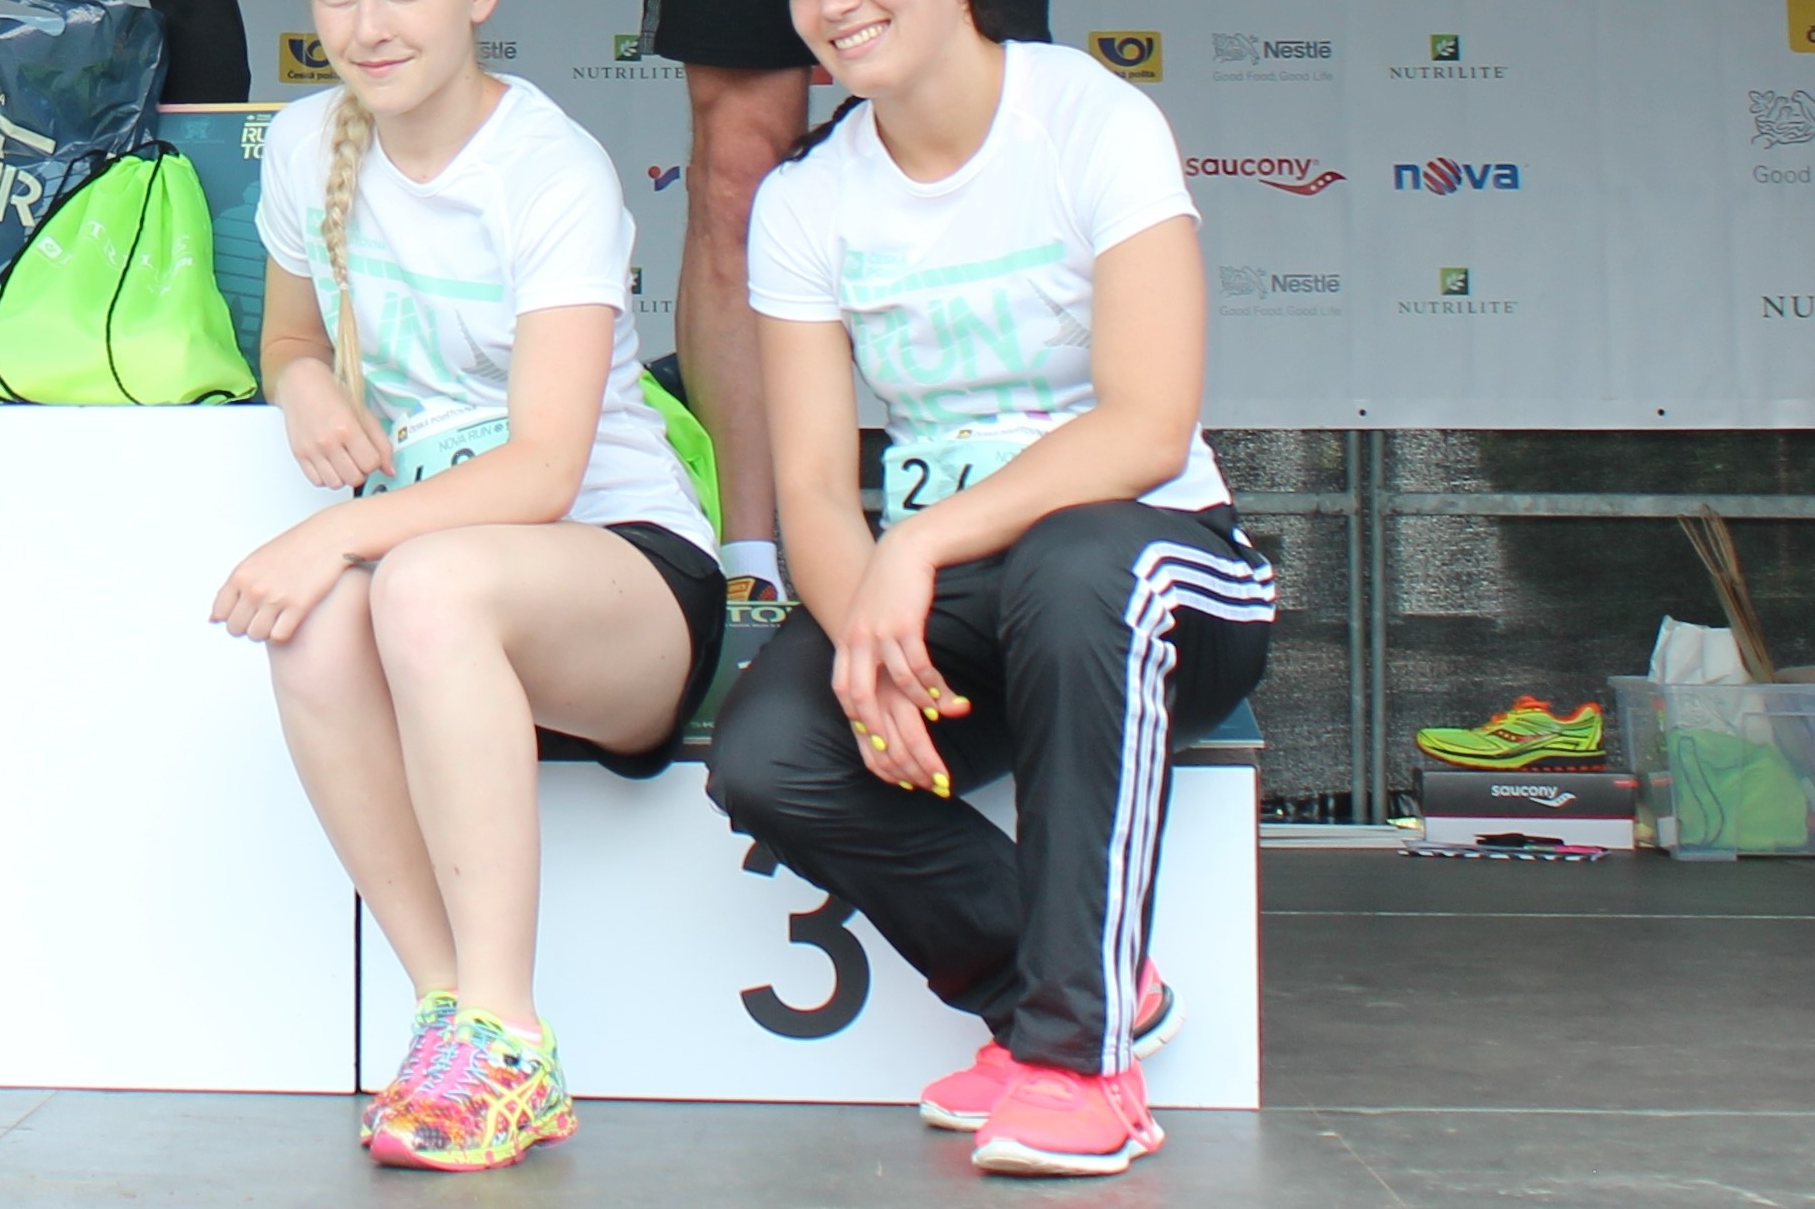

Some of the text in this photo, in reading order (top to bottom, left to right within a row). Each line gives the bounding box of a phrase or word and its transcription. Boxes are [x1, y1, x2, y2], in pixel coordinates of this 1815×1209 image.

[287, 68, 315, 79] Česká
[573, 67, 685, 80] NUTRILITE
[1212, 70, 1244, 82] Good
[1279, 71, 1309, 82] Good
[1389, 66, 1505, 80] NUTRILITE
[1186, 157, 1312, 181] saucony
[1393, 156, 1520, 196] nova
[1397, 301, 1515, 315] NUTRILITE
[438, 424, 493, 453] NOVA RUN
[1491, 784, 1558, 801] saucony
[740, 835, 871, 1040] 3
